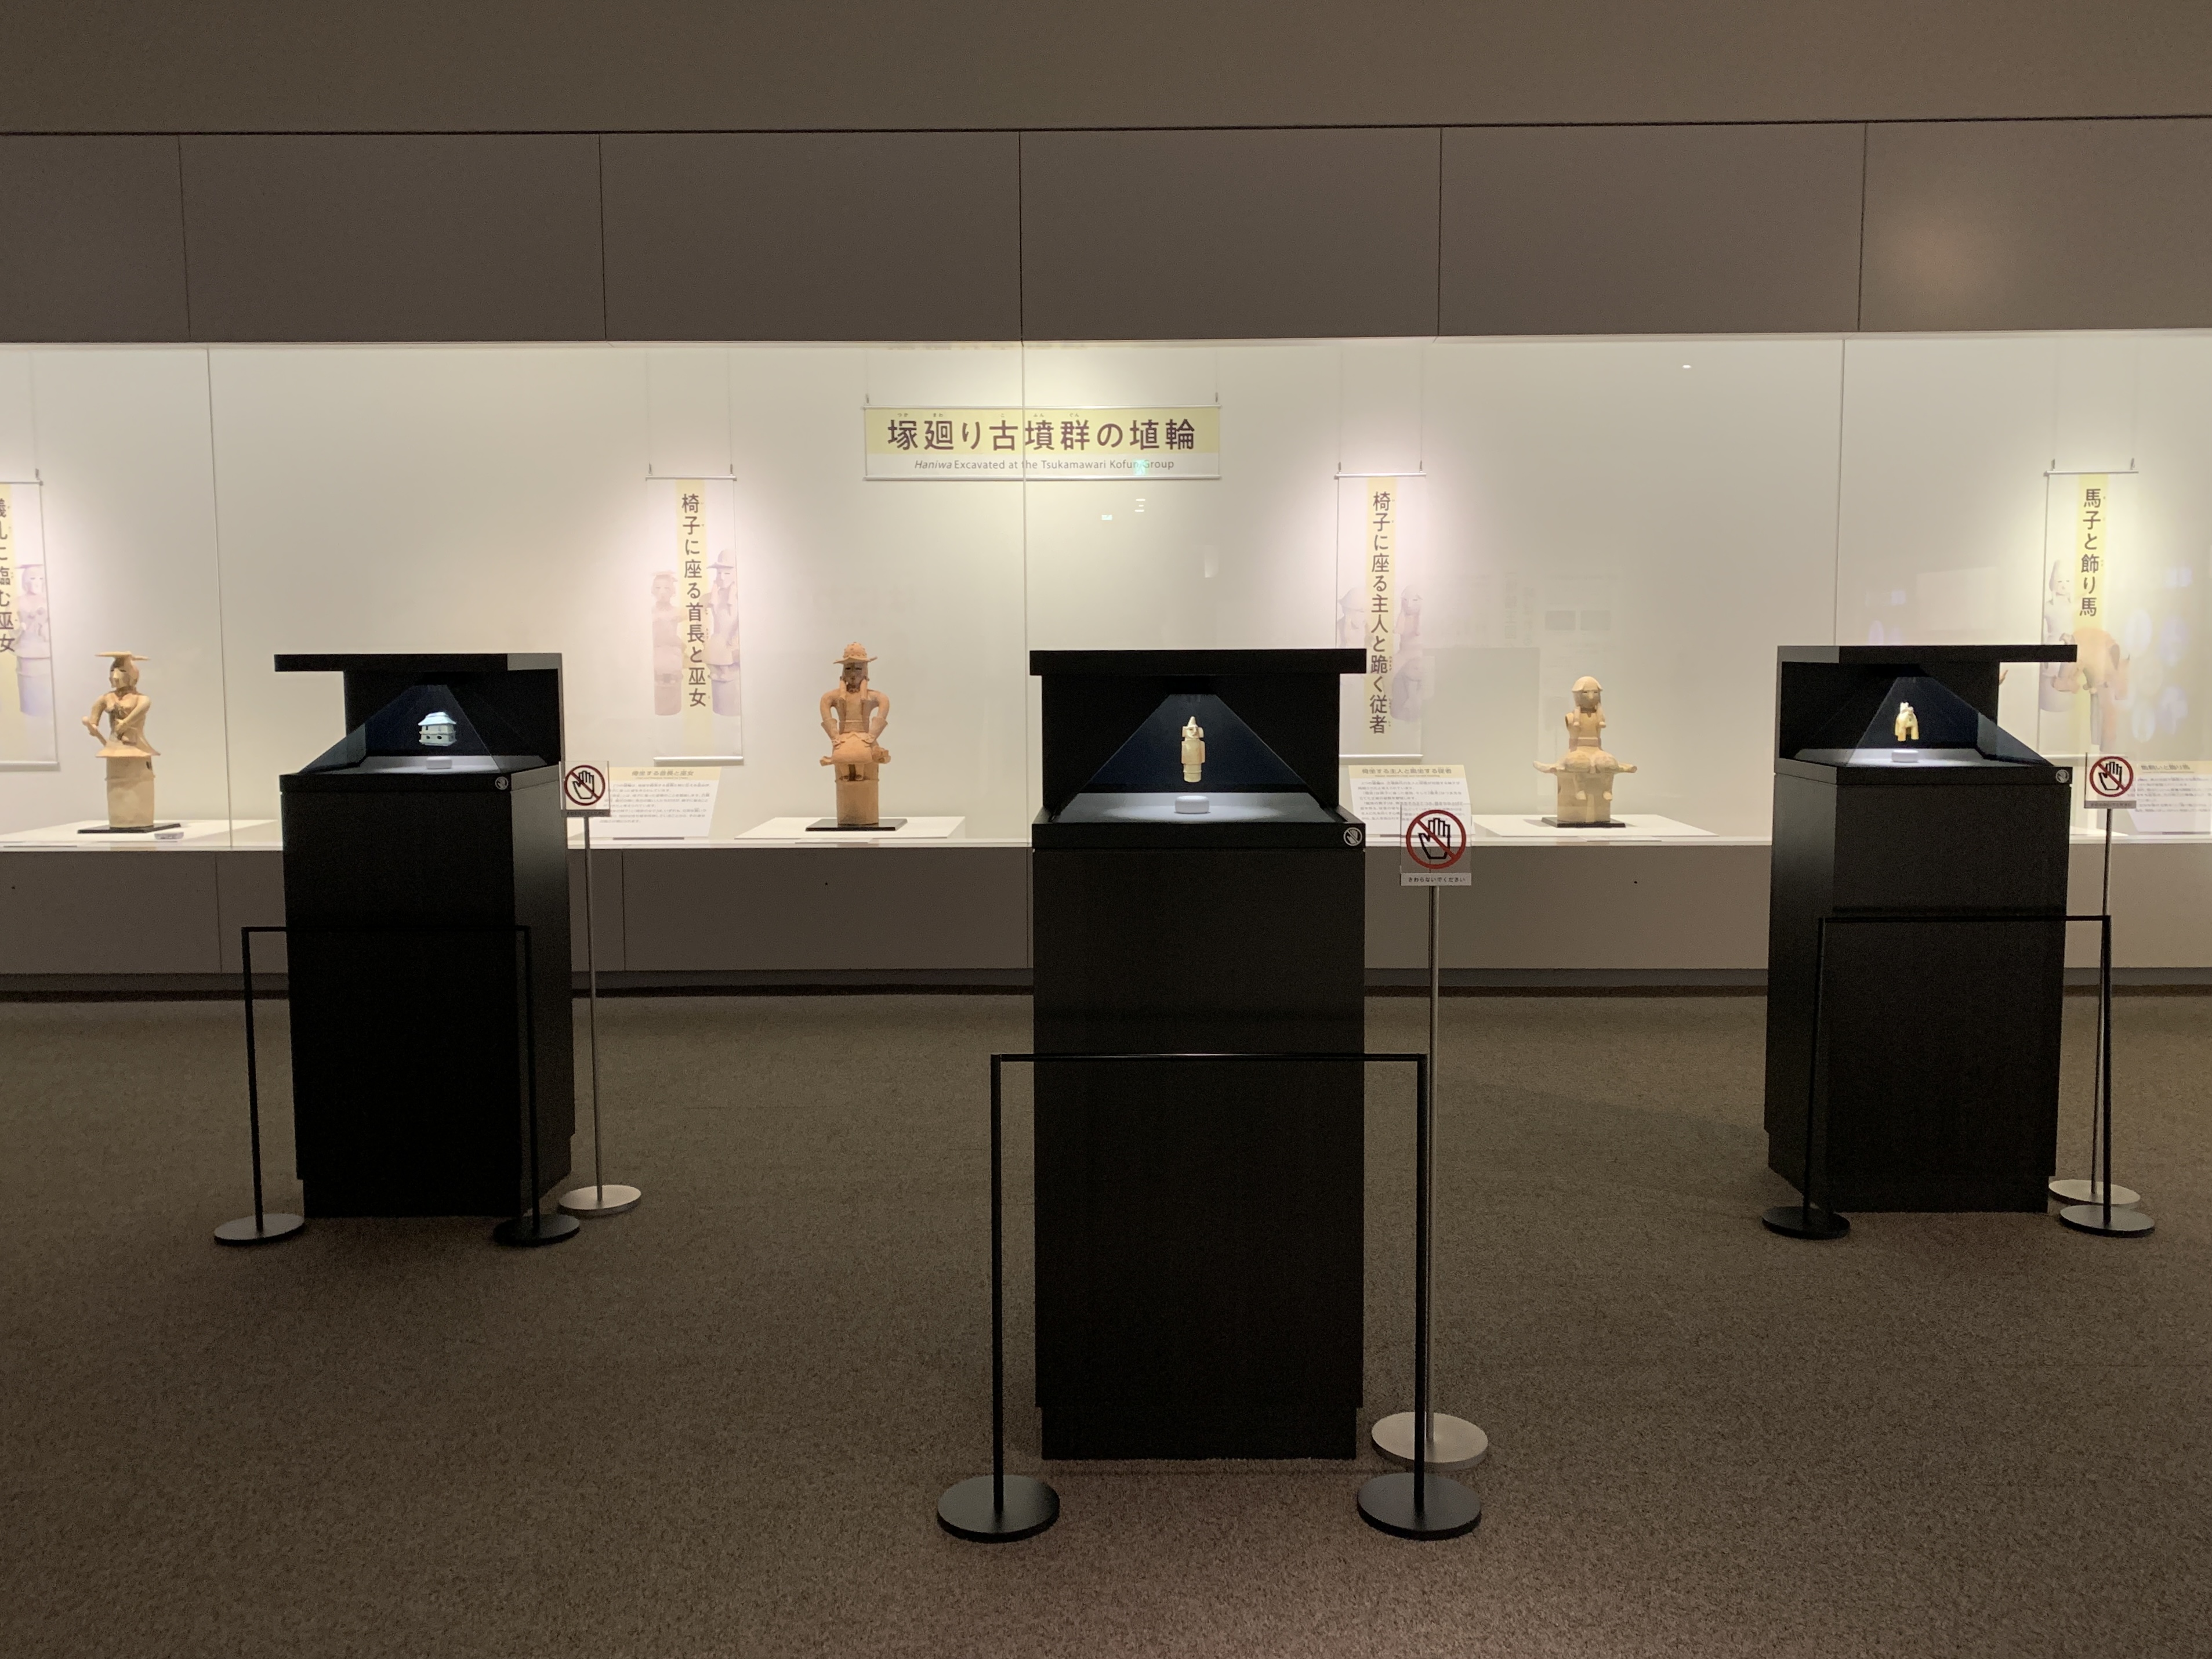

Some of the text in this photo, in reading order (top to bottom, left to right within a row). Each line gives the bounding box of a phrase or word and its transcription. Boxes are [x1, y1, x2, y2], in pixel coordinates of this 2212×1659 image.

[887, 419, 1195, 451] 塚廻り古墳群の埴輪
[915, 460, 952, 469] Haniwa
[954, 460, 1005, 469] Excavated
[1021, 460, 1038, 469] the
[1041, 460, 1106, 469] Tsukamawari
[1109, 459, 1138, 469] Kofun
[1143, 459, 1174, 470] Group
[681, 493, 706, 708] 椅子に座る首長と巫女
[1369, 491, 1391, 734] 椅子に座る主人と跪く従者
[2080, 488, 2101, 617] 馬子と飾り馬
